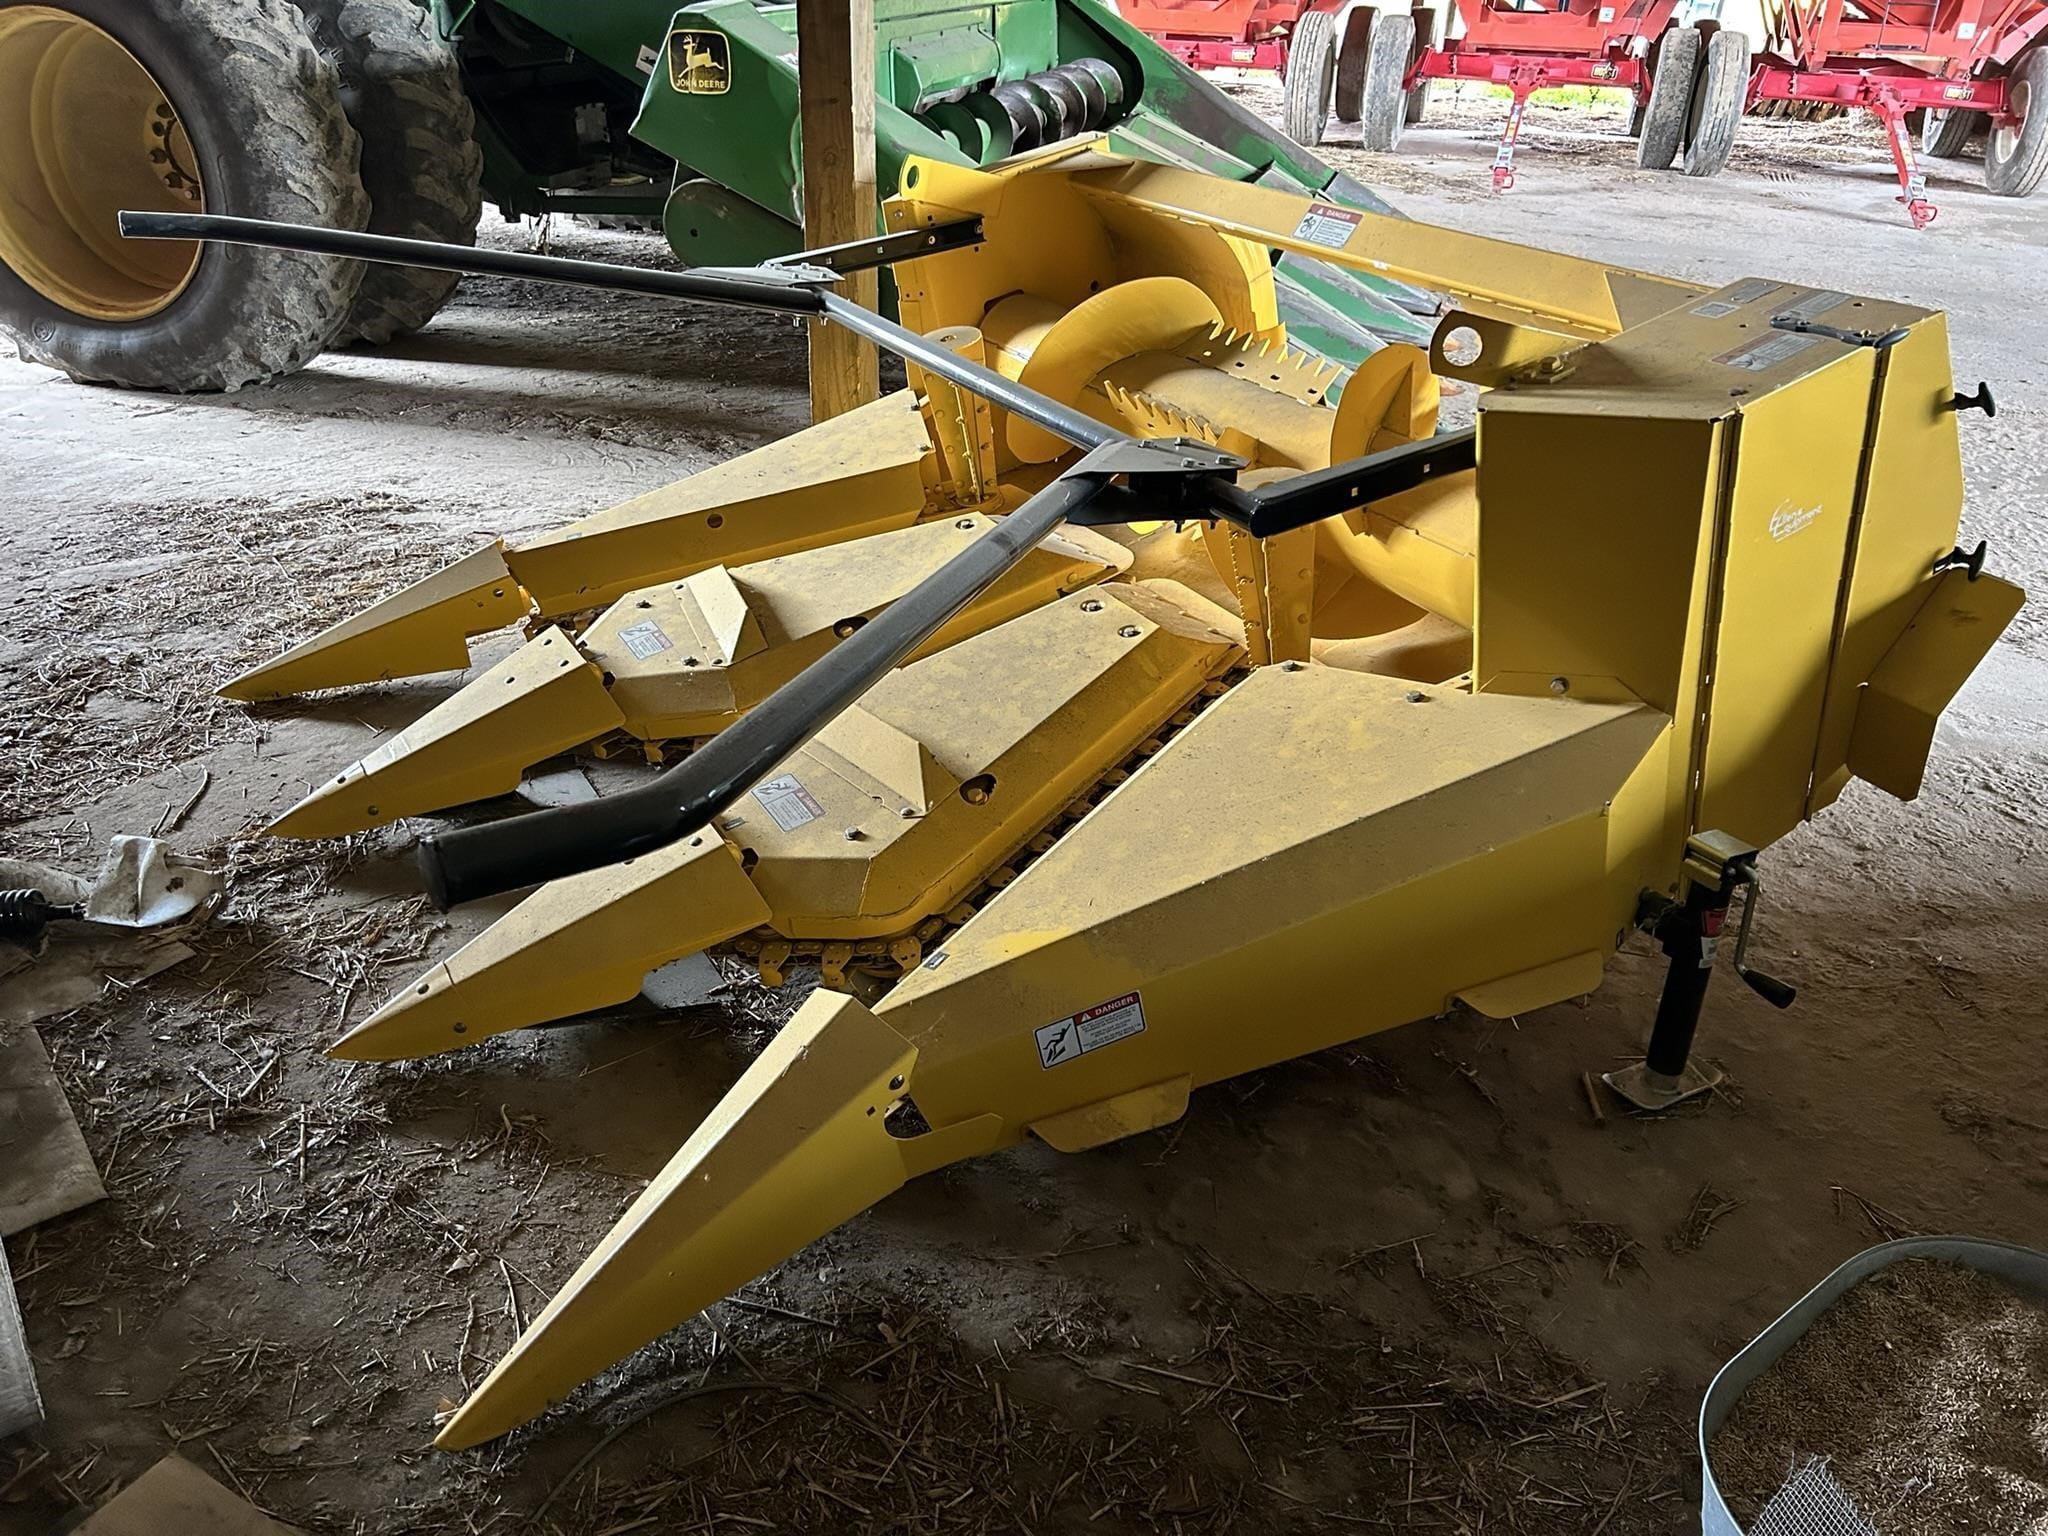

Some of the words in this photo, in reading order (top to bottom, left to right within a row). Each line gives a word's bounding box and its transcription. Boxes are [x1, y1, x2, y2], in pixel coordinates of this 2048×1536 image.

[676, 78, 698, 88] JOHN
[698, 79, 726, 89] DEERE
[1095, 996, 1134, 1016] DANGER
